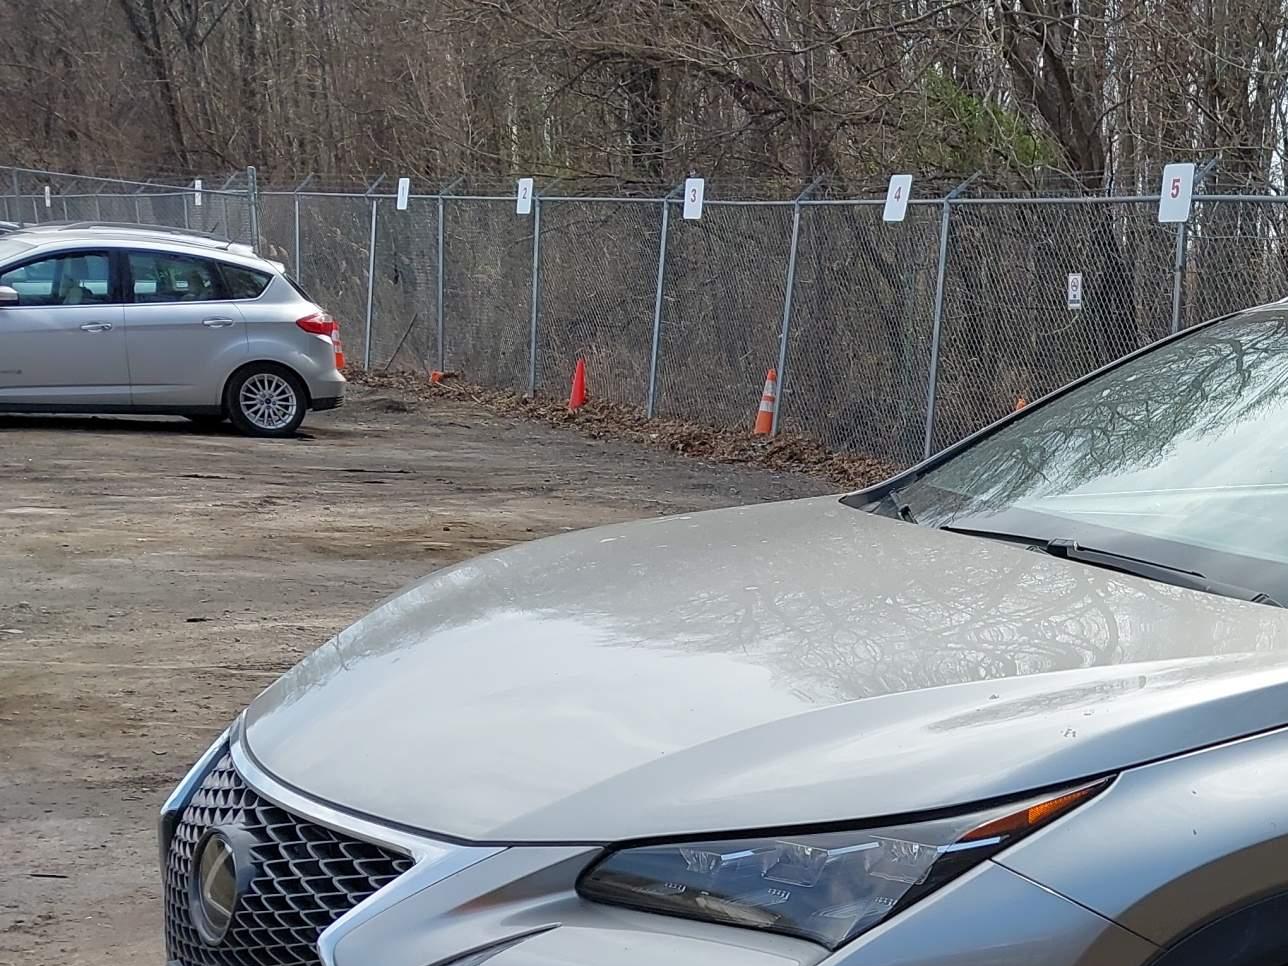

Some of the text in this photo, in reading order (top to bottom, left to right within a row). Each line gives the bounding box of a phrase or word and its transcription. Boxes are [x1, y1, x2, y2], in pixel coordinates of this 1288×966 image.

[522, 187, 528, 200] 2
[690, 188, 697, 203] 3
[894, 186, 902, 202] 4
[1171, 178, 1181, 199] 5
